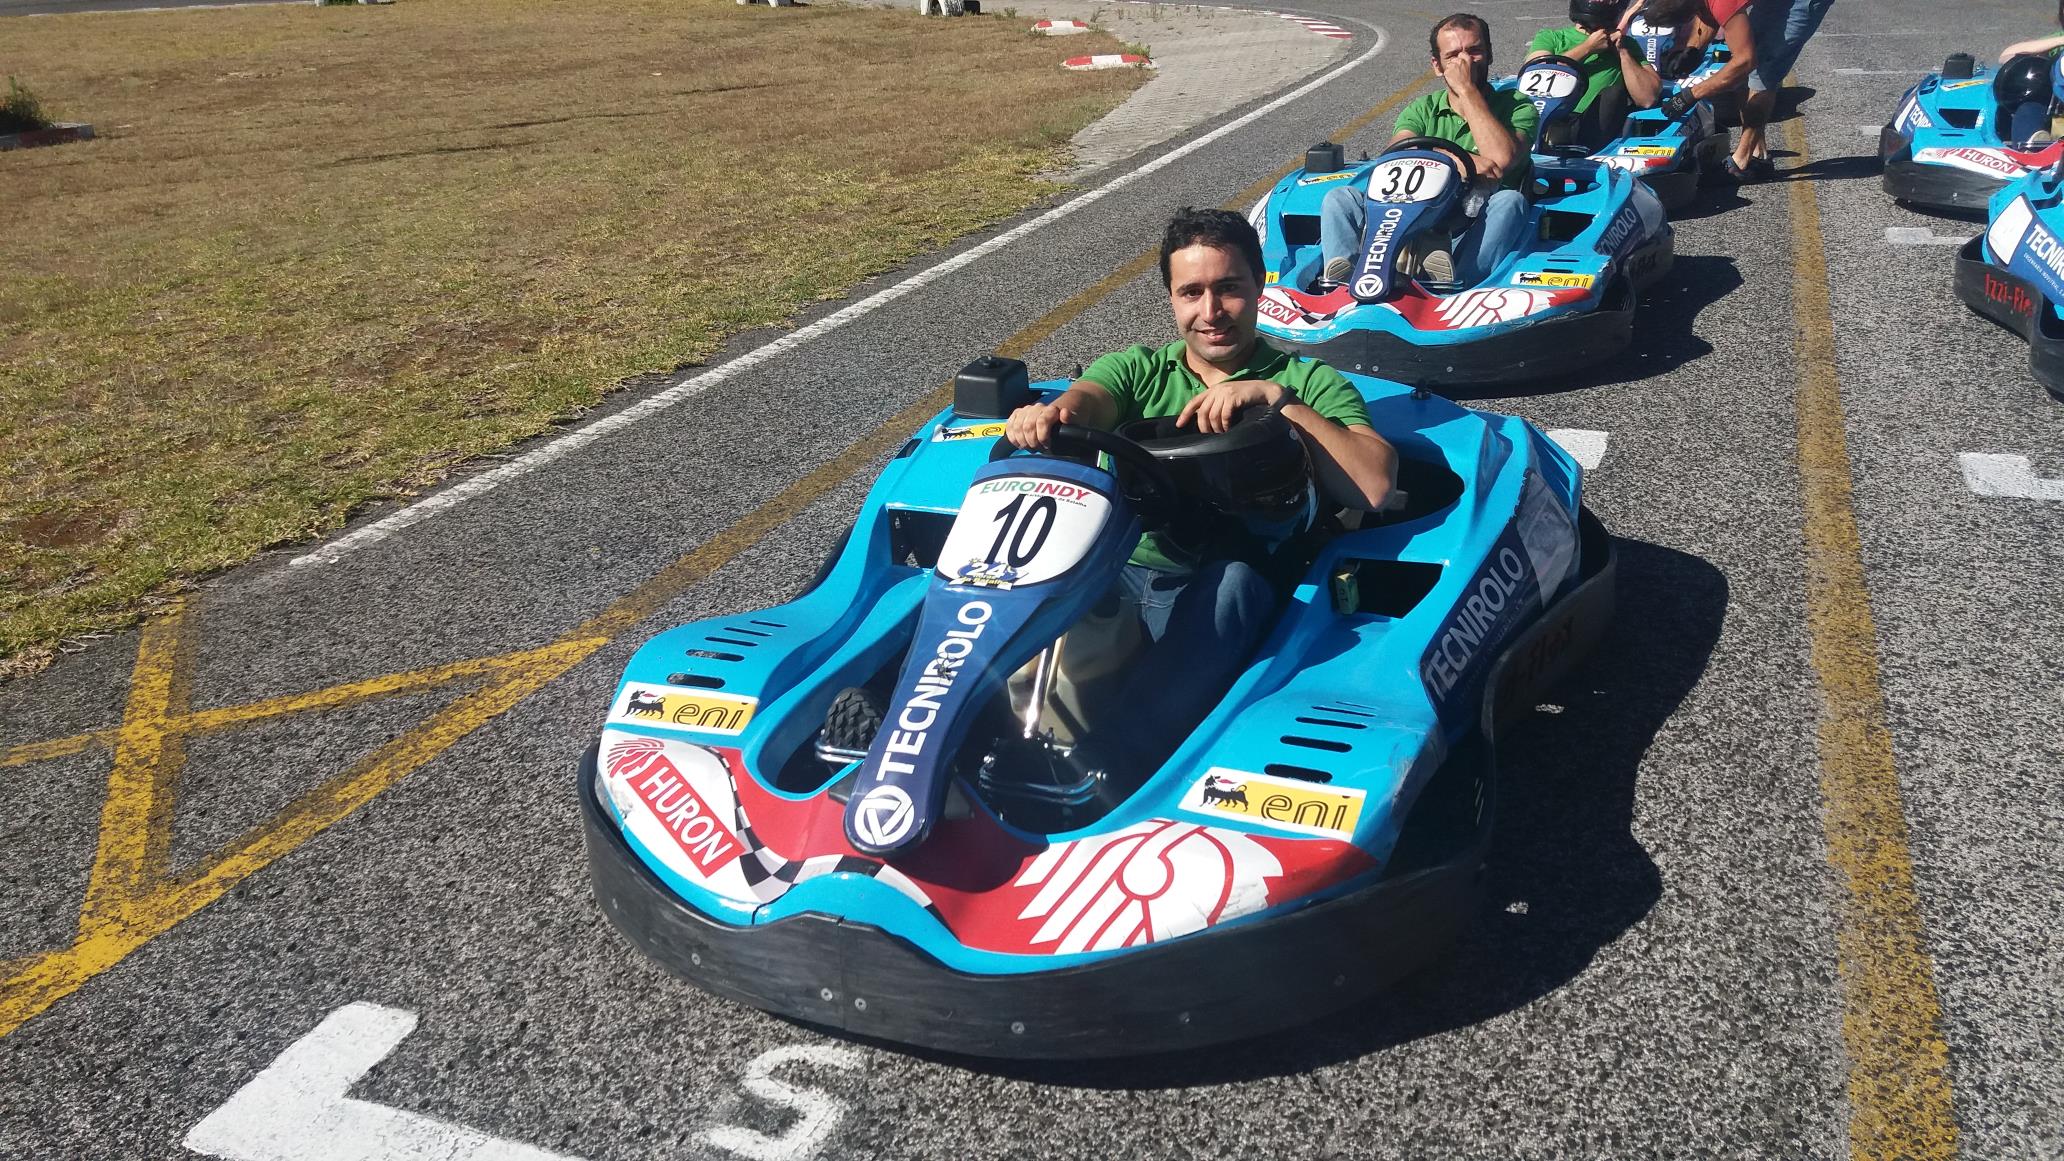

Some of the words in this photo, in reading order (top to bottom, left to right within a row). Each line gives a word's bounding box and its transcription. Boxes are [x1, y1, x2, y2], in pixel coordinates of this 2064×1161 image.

[1526, 73, 1557, 93] 21
[1384, 160, 1441, 168] EUROINDY
[1962, 149, 2013, 173] HURON
[1381, 166, 1425, 195] 30
[1364, 208, 1402, 273] TECNIROLO
[1599, 207, 1637, 256] CNIROLO
[1548, 275, 1590, 288] eni
[980, 480, 1092, 501] EUROINDY
[984, 493, 1057, 568] 10
[1424, 546, 1525, 703] TECNIROLO
[876, 600, 992, 781] TECNIROLO
[672, 702, 748, 730] eni
[639, 766, 733, 867] HURON
[1261, 794, 1351, 831] eni
